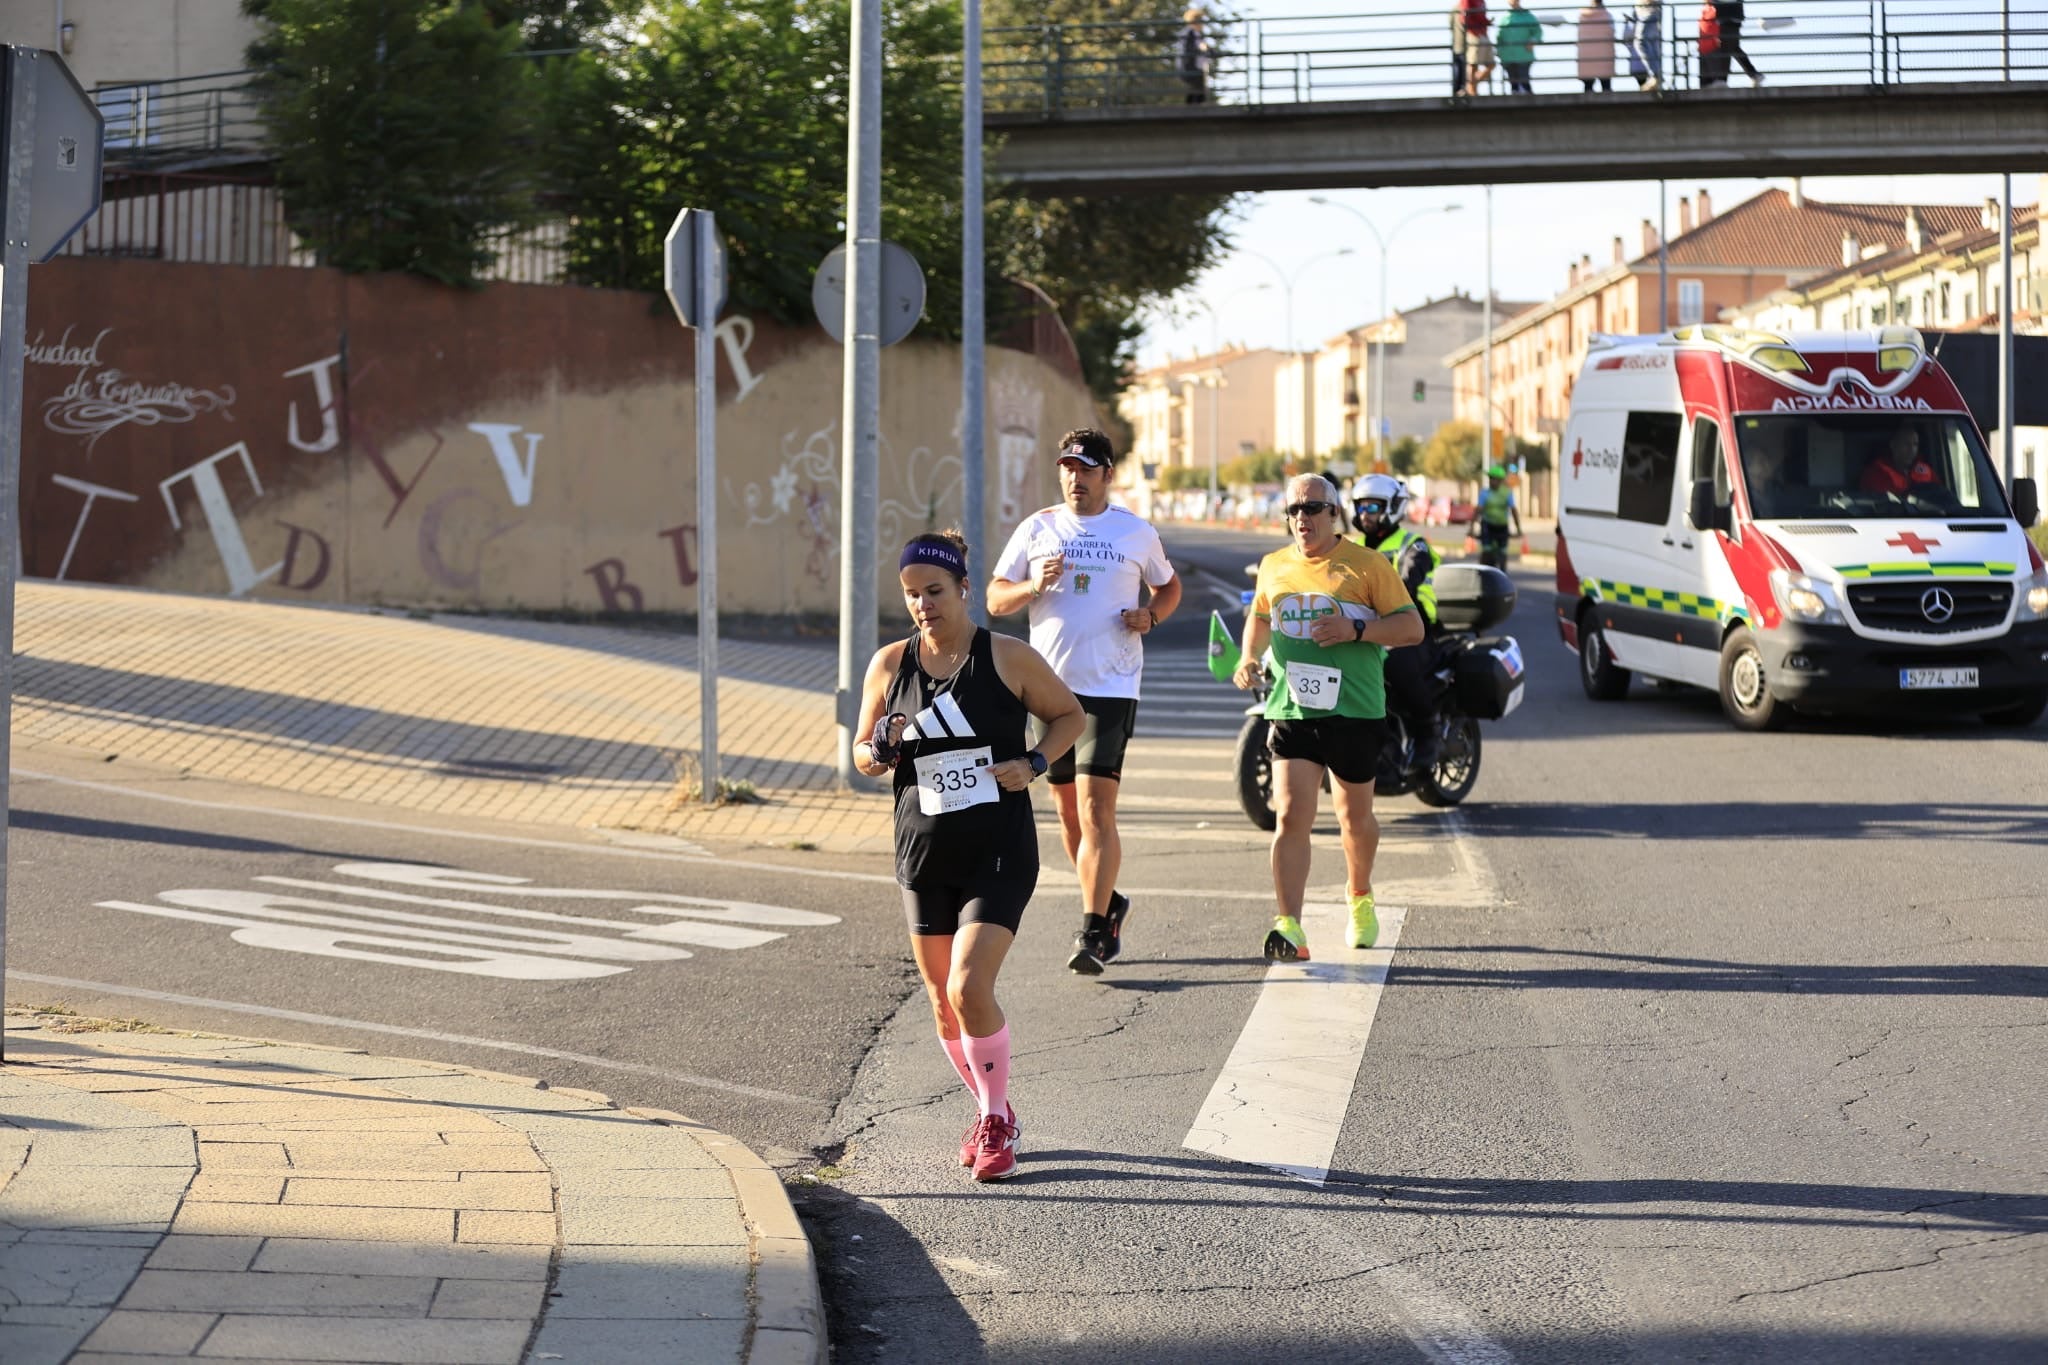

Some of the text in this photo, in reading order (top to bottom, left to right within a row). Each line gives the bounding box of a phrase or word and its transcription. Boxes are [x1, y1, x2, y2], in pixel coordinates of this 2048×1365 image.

[1070, 540, 1113, 549] CARRERA
[918, 547, 958, 565] KIPRUN
[1299, 678, 1321, 696] 33
[1909, 670, 1976, 686] 5774 JJM
[932, 767, 977, 793] 335
